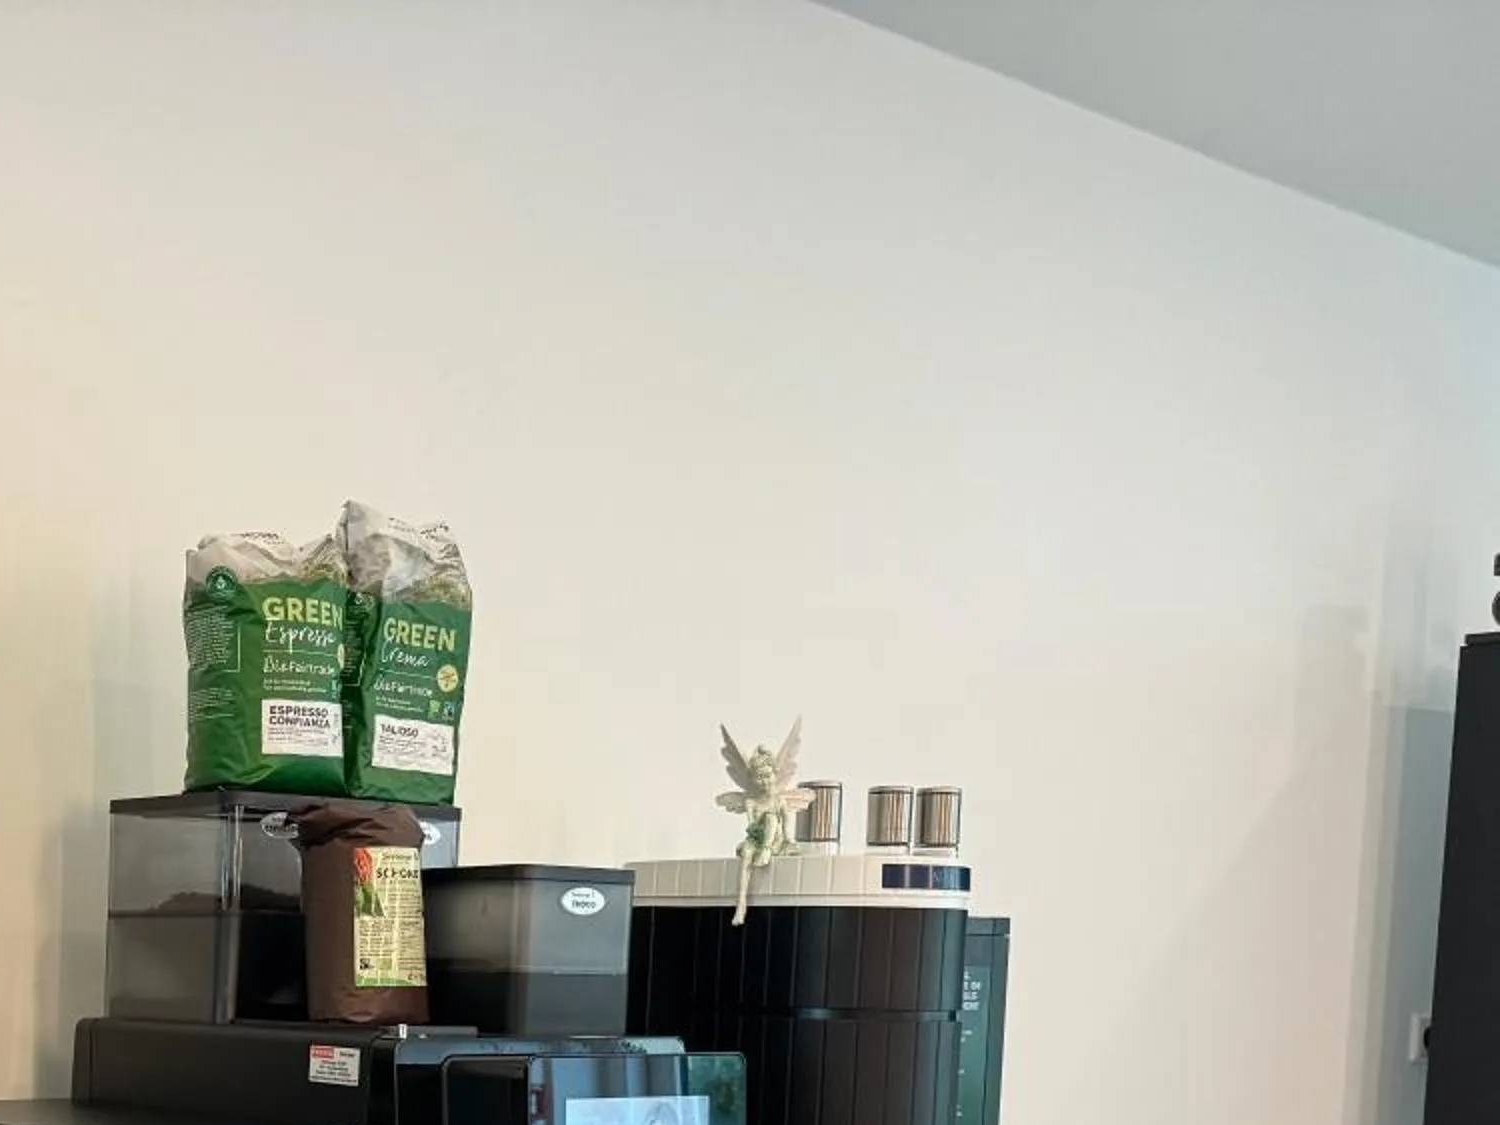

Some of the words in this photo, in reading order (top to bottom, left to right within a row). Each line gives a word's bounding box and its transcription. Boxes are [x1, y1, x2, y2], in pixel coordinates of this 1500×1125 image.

[263, 597, 343, 630] GREEN
[265, 621, 337, 654] Espresso
[383, 617, 457, 651] GREEN
[380, 640, 431, 667] Crema
[269, 705, 328, 717] ESPRESSO
